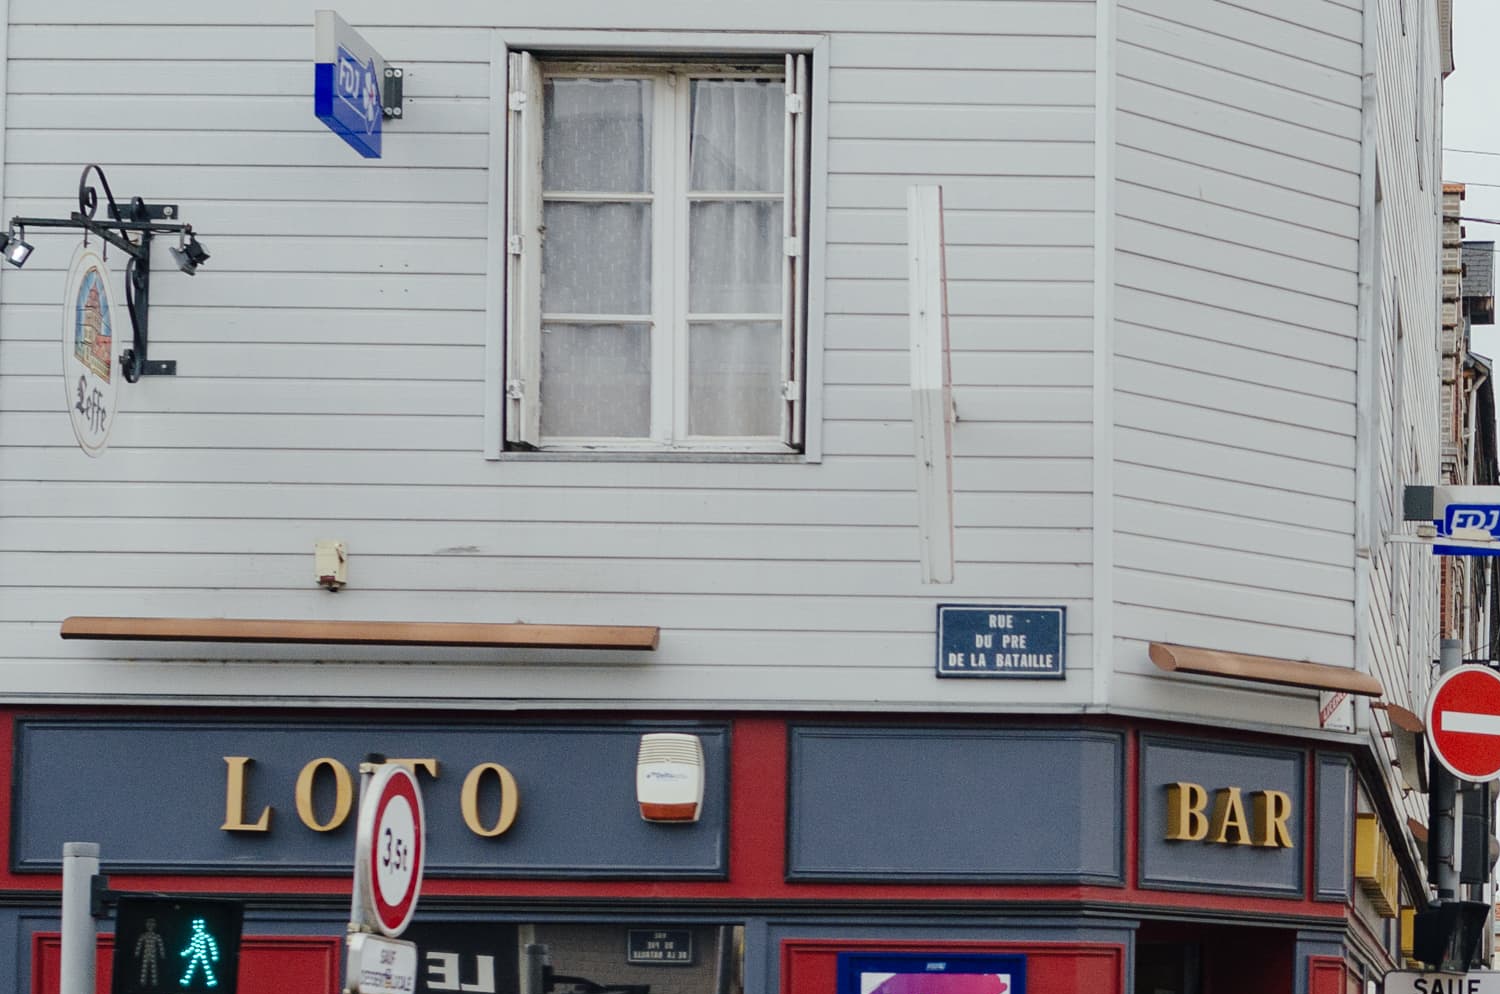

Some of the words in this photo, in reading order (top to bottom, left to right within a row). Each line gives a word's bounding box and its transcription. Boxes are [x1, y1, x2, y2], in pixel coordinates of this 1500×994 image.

[339, 57, 360, 98] FDJ
[75, 374, 107, 434] Leffe
[1451, 509, 1500, 531] FDJ
[988, 614, 1013, 628] RUE
[975, 634, 992, 648] DU
[1002, 635, 1027, 648] PRE
[948, 653, 965, 667] DE
[970, 653, 986, 667] LA
[995, 653, 1053, 668] BATAILLE
[1167, 782, 1294, 848] BAR
[383, 827, 408, 873] 3,5t
